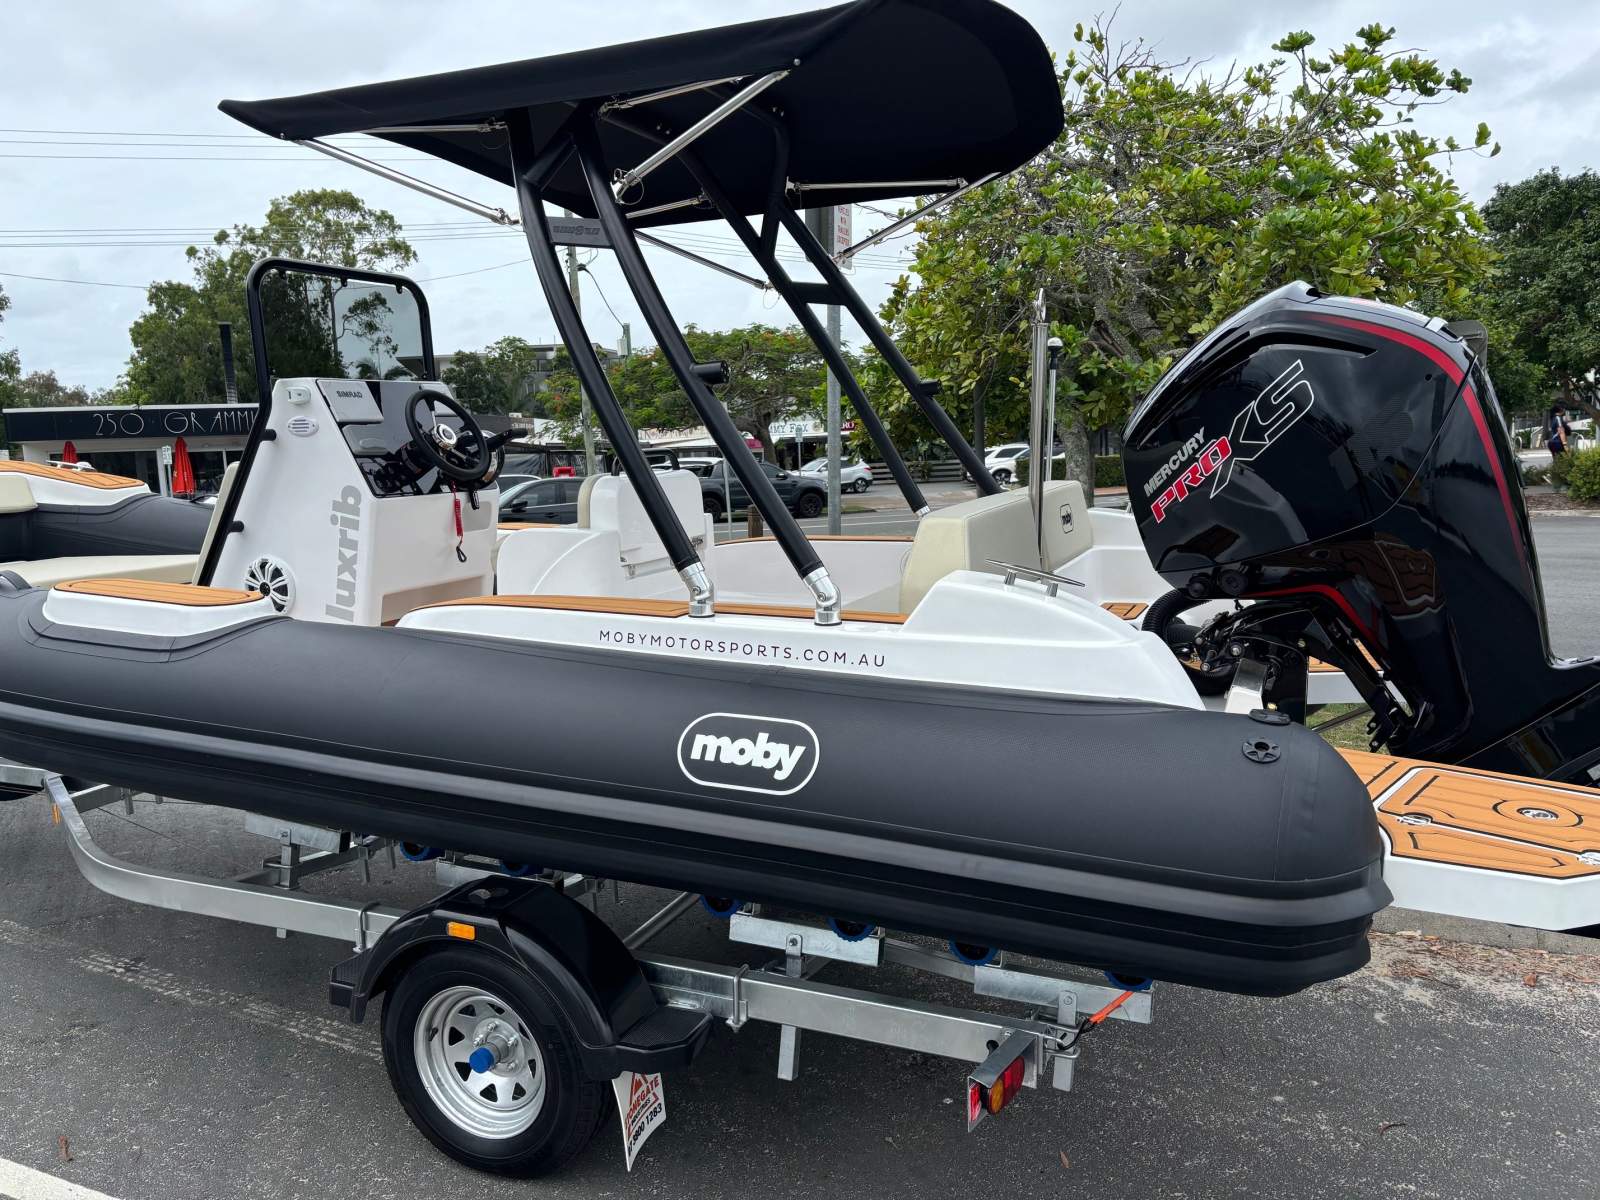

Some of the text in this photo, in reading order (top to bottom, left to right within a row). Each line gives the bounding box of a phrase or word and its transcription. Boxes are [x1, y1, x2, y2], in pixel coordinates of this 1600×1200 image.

[336, 390, 363, 399] SIMRAD
[93, 412, 145, 436] 250
[1143, 426, 1205, 498] MERCURY
[325, 485, 362, 623] luxrib
[599, 630, 886, 667] MOBYMOTORSPORTS.COM.AU
[690, 732, 807, 780] moby
[645, 1102, 663, 1125] 1283
